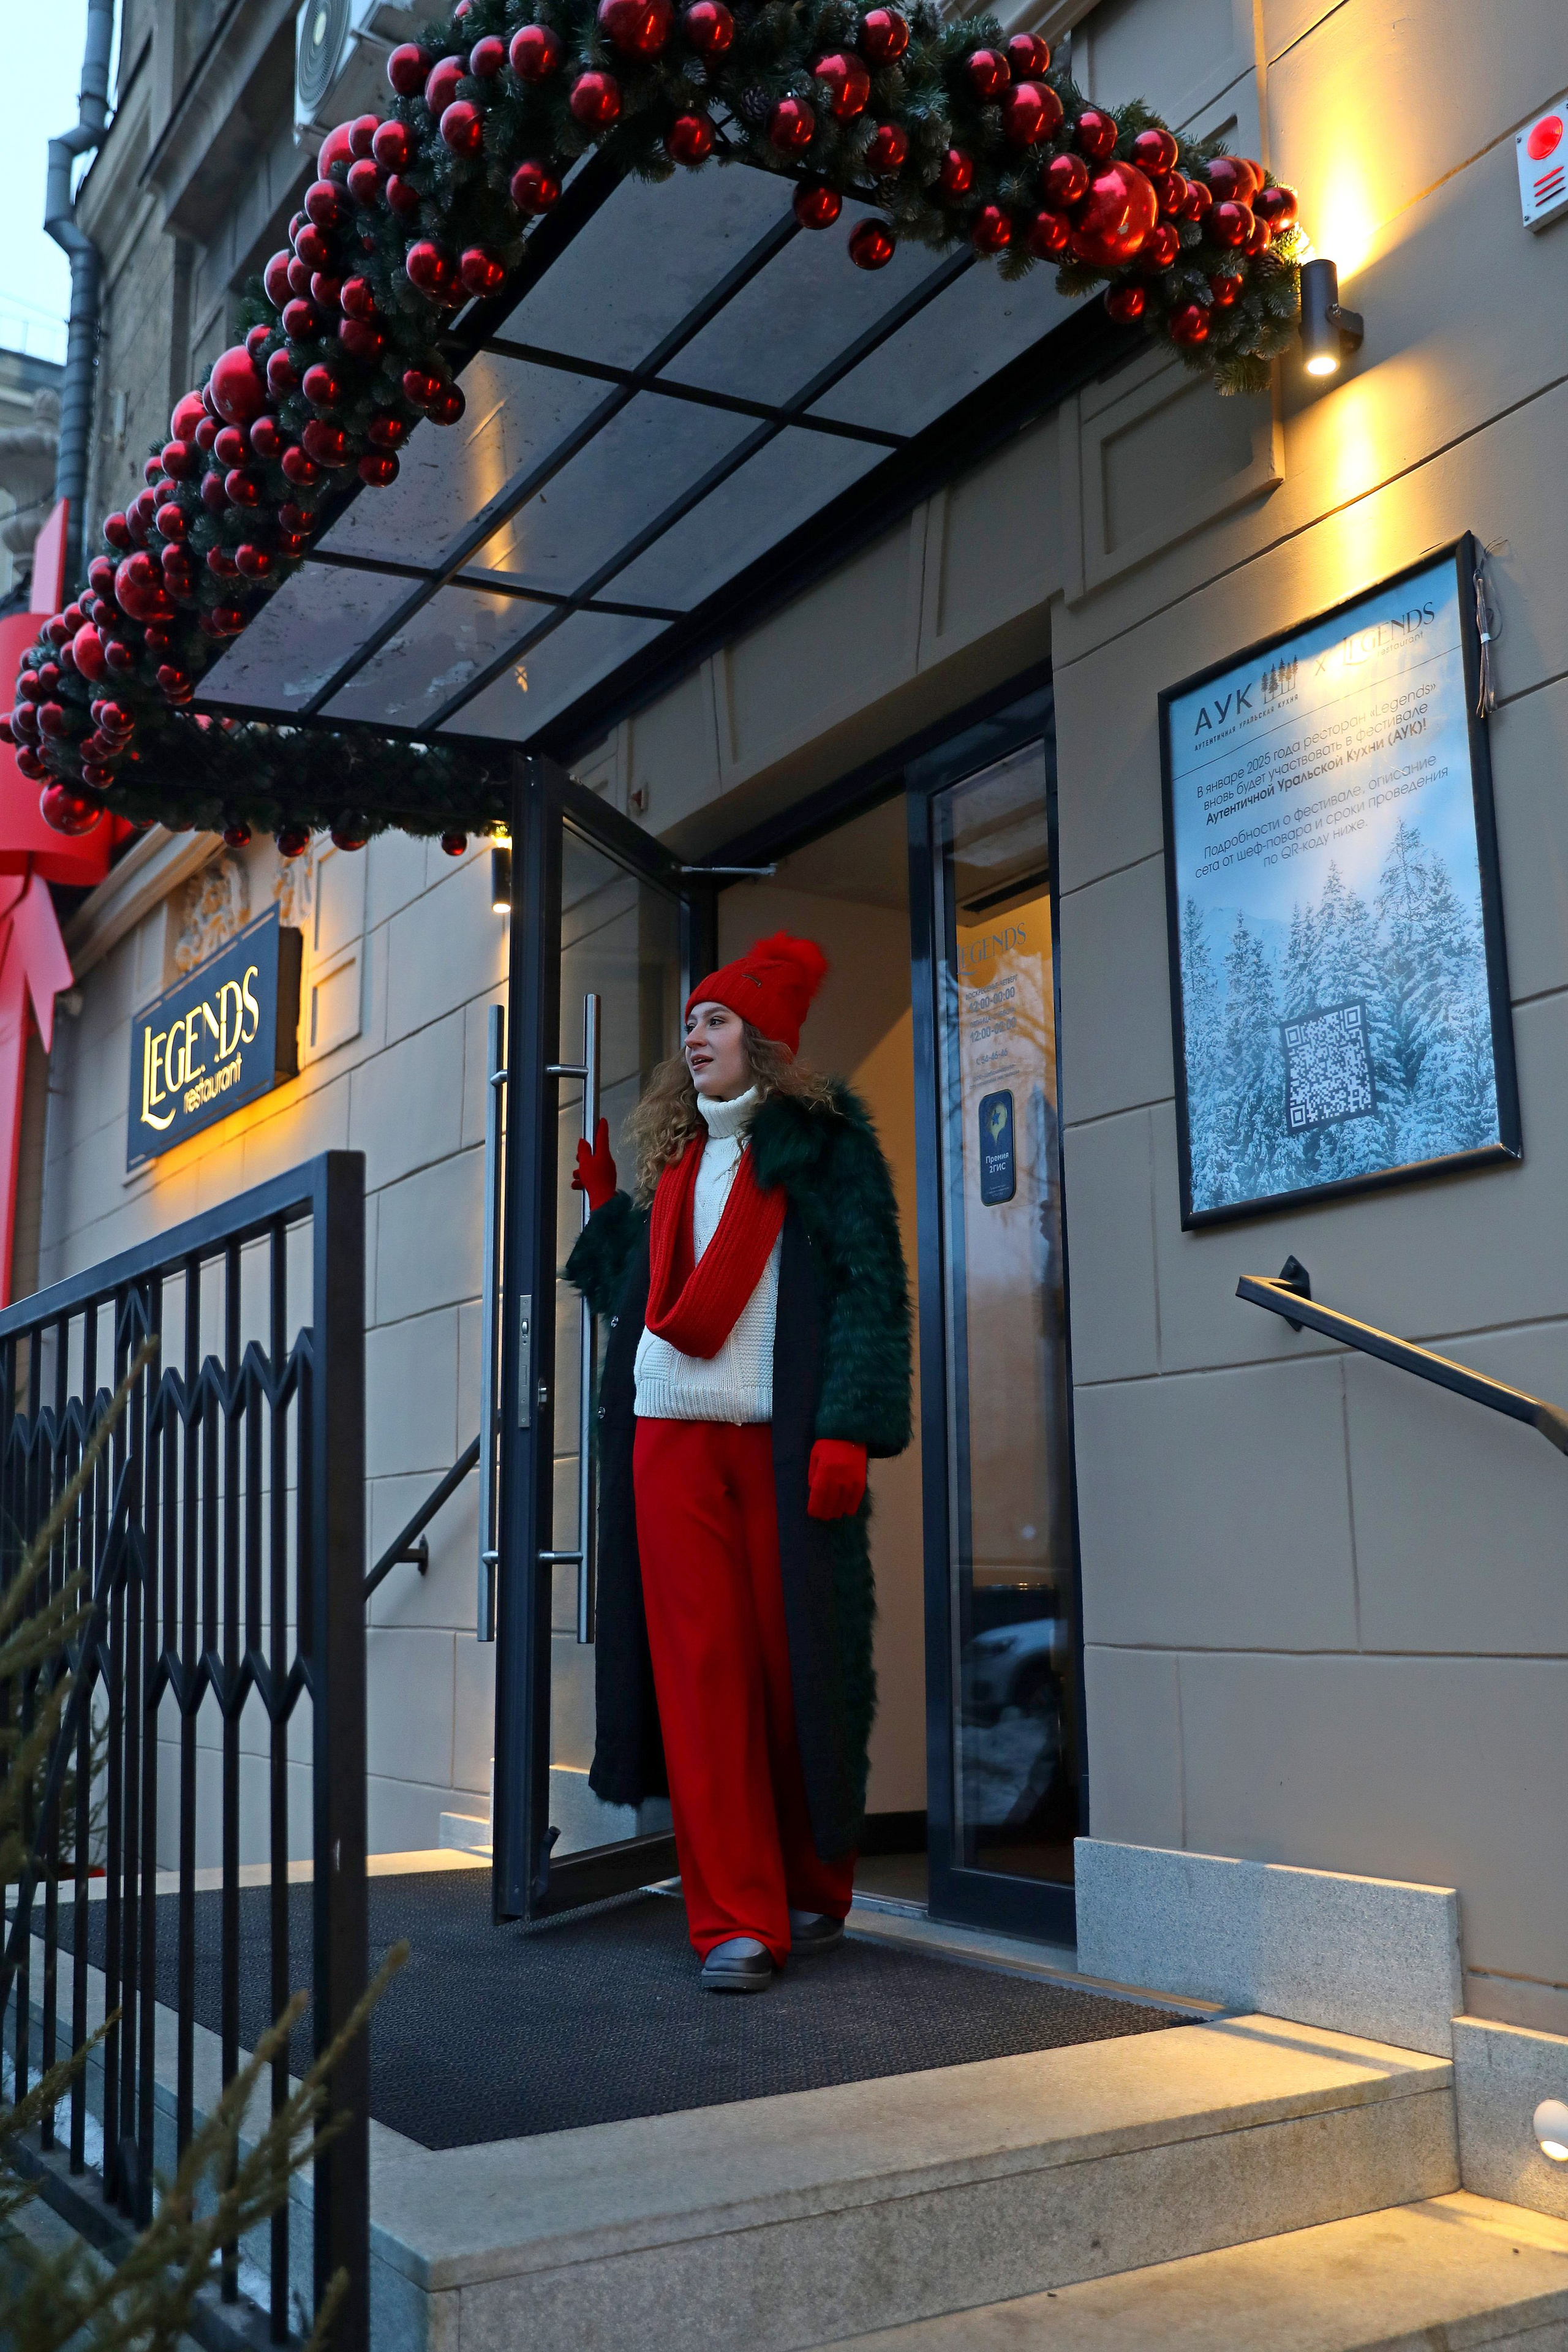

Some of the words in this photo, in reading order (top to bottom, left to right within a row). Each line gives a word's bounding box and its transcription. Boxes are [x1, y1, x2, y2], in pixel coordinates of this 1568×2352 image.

[1378, 630, 1423, 657] restaurant
[1195, 683, 1253, 736] АУК
[1195, 726, 1236, 752] АУТЕНТИЧНАЯ
[1239, 706, 1275, 729] УРАЛЬСКАЯ
[1278, 694, 1298, 709] КУХНЯ
[1197, 786, 1204, 798] В
[1206, 769, 1244, 794] январе
[1247, 752, 1270, 774] 2025
[1273, 741, 1300, 761] года
[1304, 713, 1365, 750] ресторан
[1370, 684, 1436, 717] «Legends»
[1204, 791, 1234, 811] вновь
[1237, 773, 1265, 794] будет
[1268, 741, 1342, 782] участвовать
[1346, 736, 1352, 746] в
[1356, 704, 1428, 743] фестивале
[1207, 783, 1275, 826] Аутентичной
[1277, 755, 1343, 792] Уральской
[1347, 739, 1384, 763] Кухни
[1388, 718, 1427, 746] (АУК)!
[1196, 860, 1219, 878] сета
[1223, 854, 1233, 867] от
[1237, 823, 1311, 861] шеф-повара
[1316, 818, 1322, 829] и
[1326, 802, 1365, 825] сроки
[1368, 767, 1448, 809] проведения
[1204, 819, 1280, 859] Подробности
[1283, 815, 1291, 825] о
[1294, 785, 1365, 822] фестивале,
[1368, 755, 1436, 790] описание
[1264, 854, 1278, 867] по
[1281, 832, 1329, 859] QR-коду
[1333, 819, 1368, 839] ниже.
[957, 922, 1026, 975] LEGENDS
[141, 965, 259, 1130] LEGENDS
[184, 1051, 243, 1114] restaurant
[986, 1152, 1009, 1164] Премия
[990, 1163, 1006, 1174] 2ГИС
